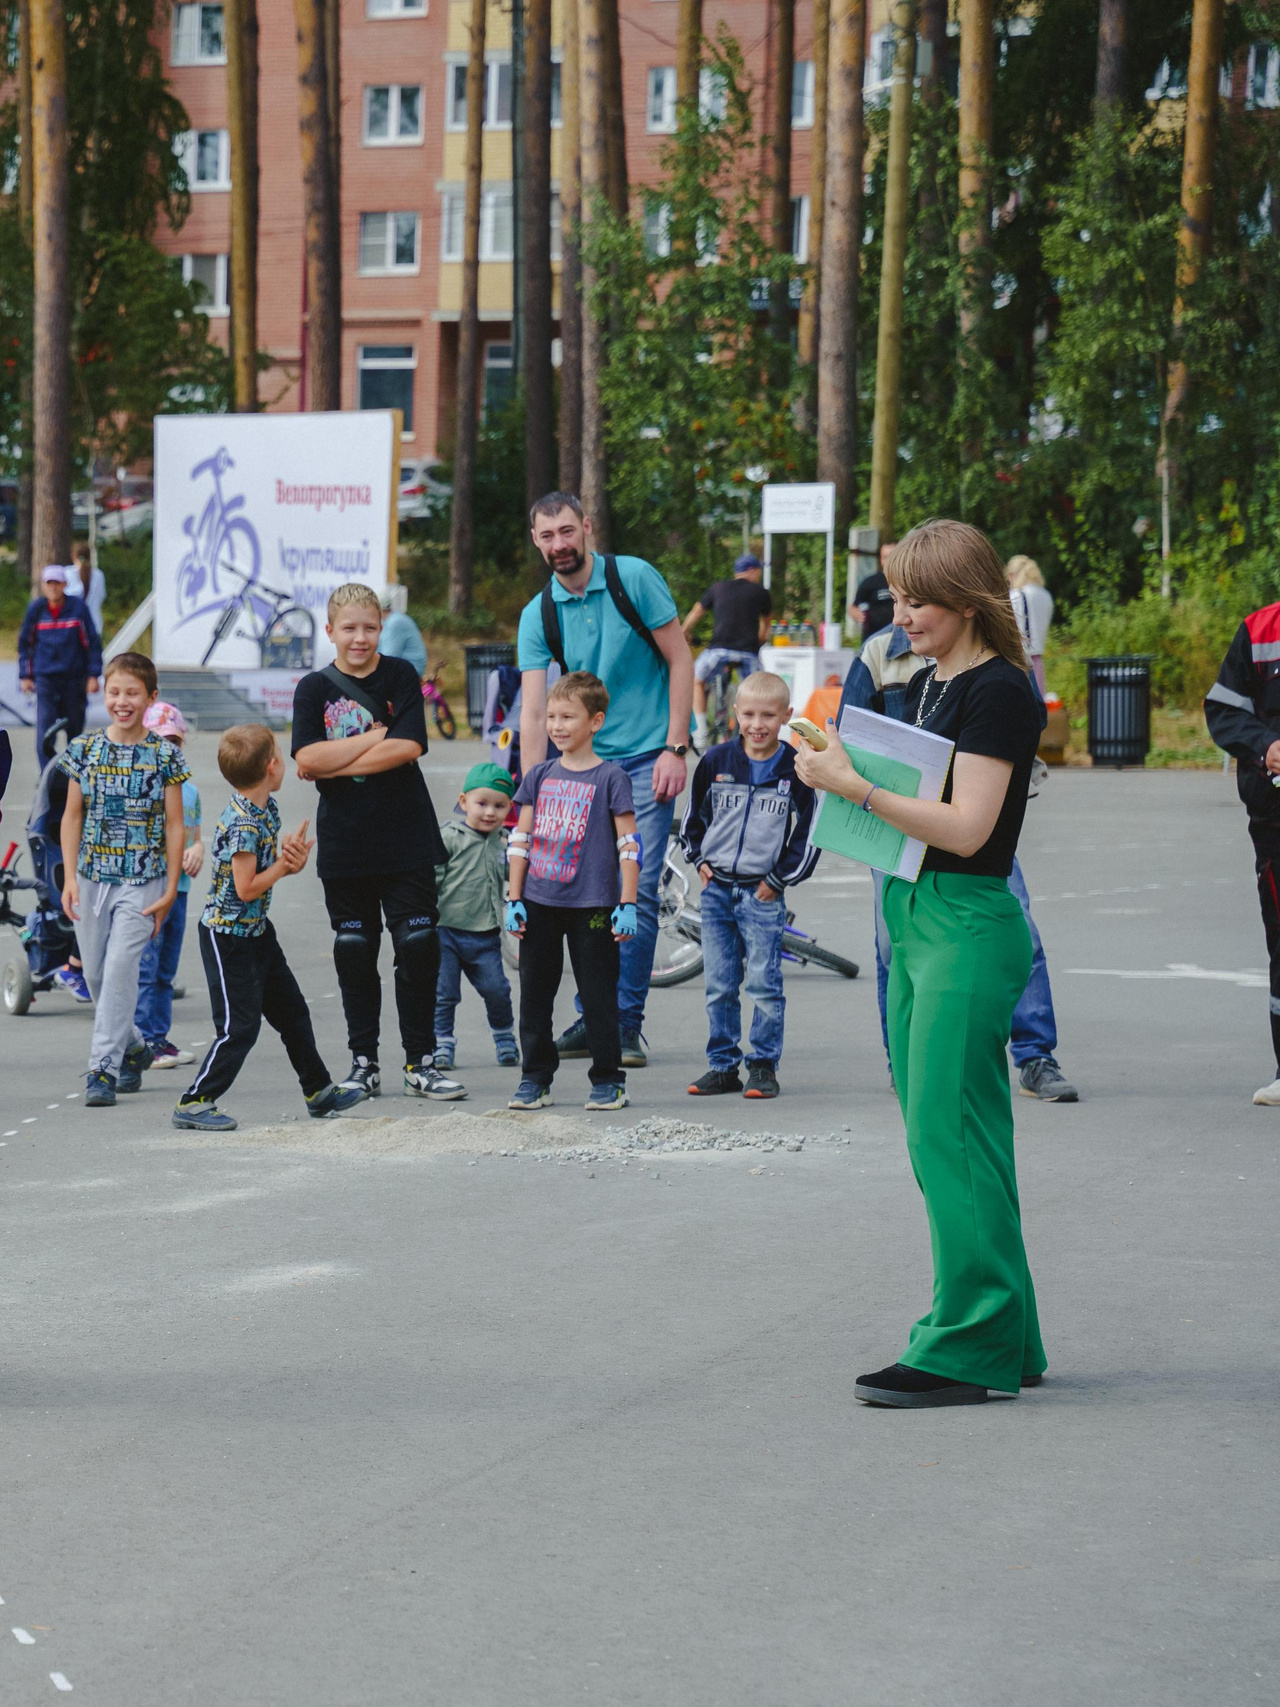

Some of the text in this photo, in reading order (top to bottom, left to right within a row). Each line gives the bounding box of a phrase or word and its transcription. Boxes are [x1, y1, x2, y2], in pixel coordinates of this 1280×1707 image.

[275, 478, 370, 512] Велопрогулка
[557, 779, 596, 802] SANTA
[124, 798, 153, 808] SKATE
[536, 796, 589, 823] MONICA
[759, 798, 788, 816] TOG
[565, 821, 586, 843] 68
